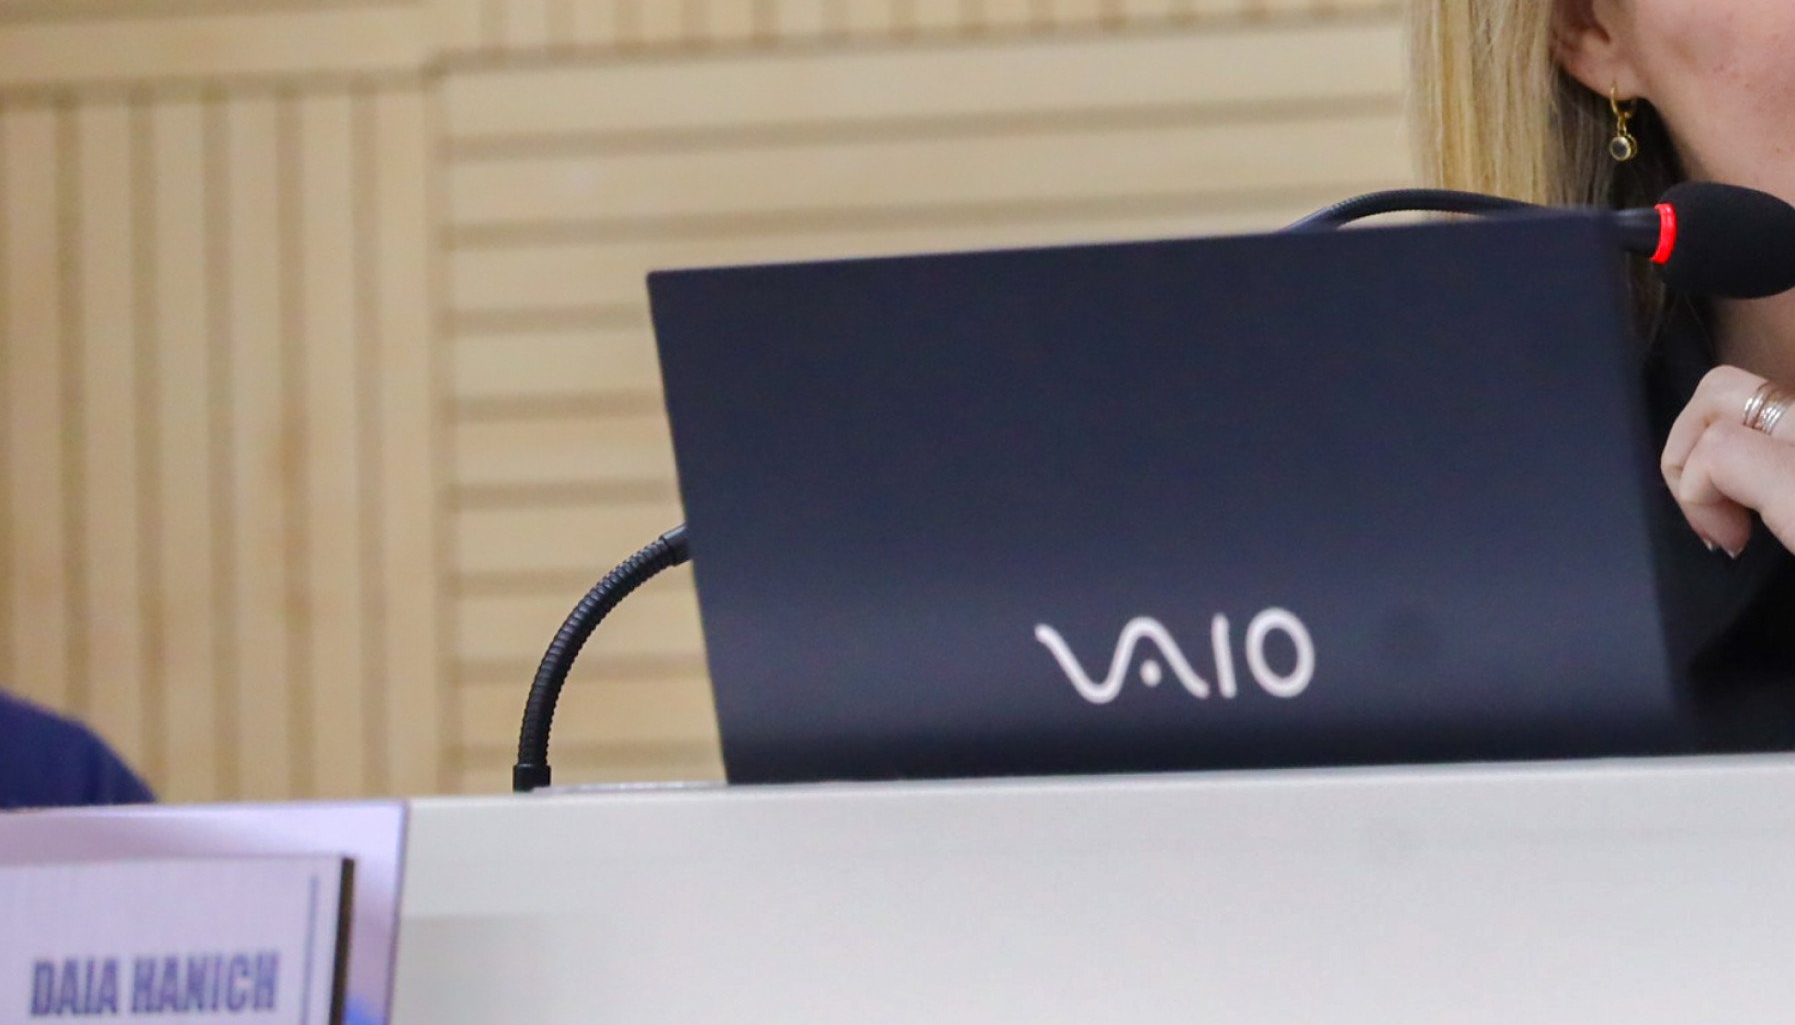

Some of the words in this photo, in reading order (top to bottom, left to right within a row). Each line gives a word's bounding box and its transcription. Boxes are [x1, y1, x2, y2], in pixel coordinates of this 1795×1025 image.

[1035, 607, 1314, 703] VAIO
[29, 955, 118, 1017] DAIA
[131, 950, 279, 1013] HANICH
